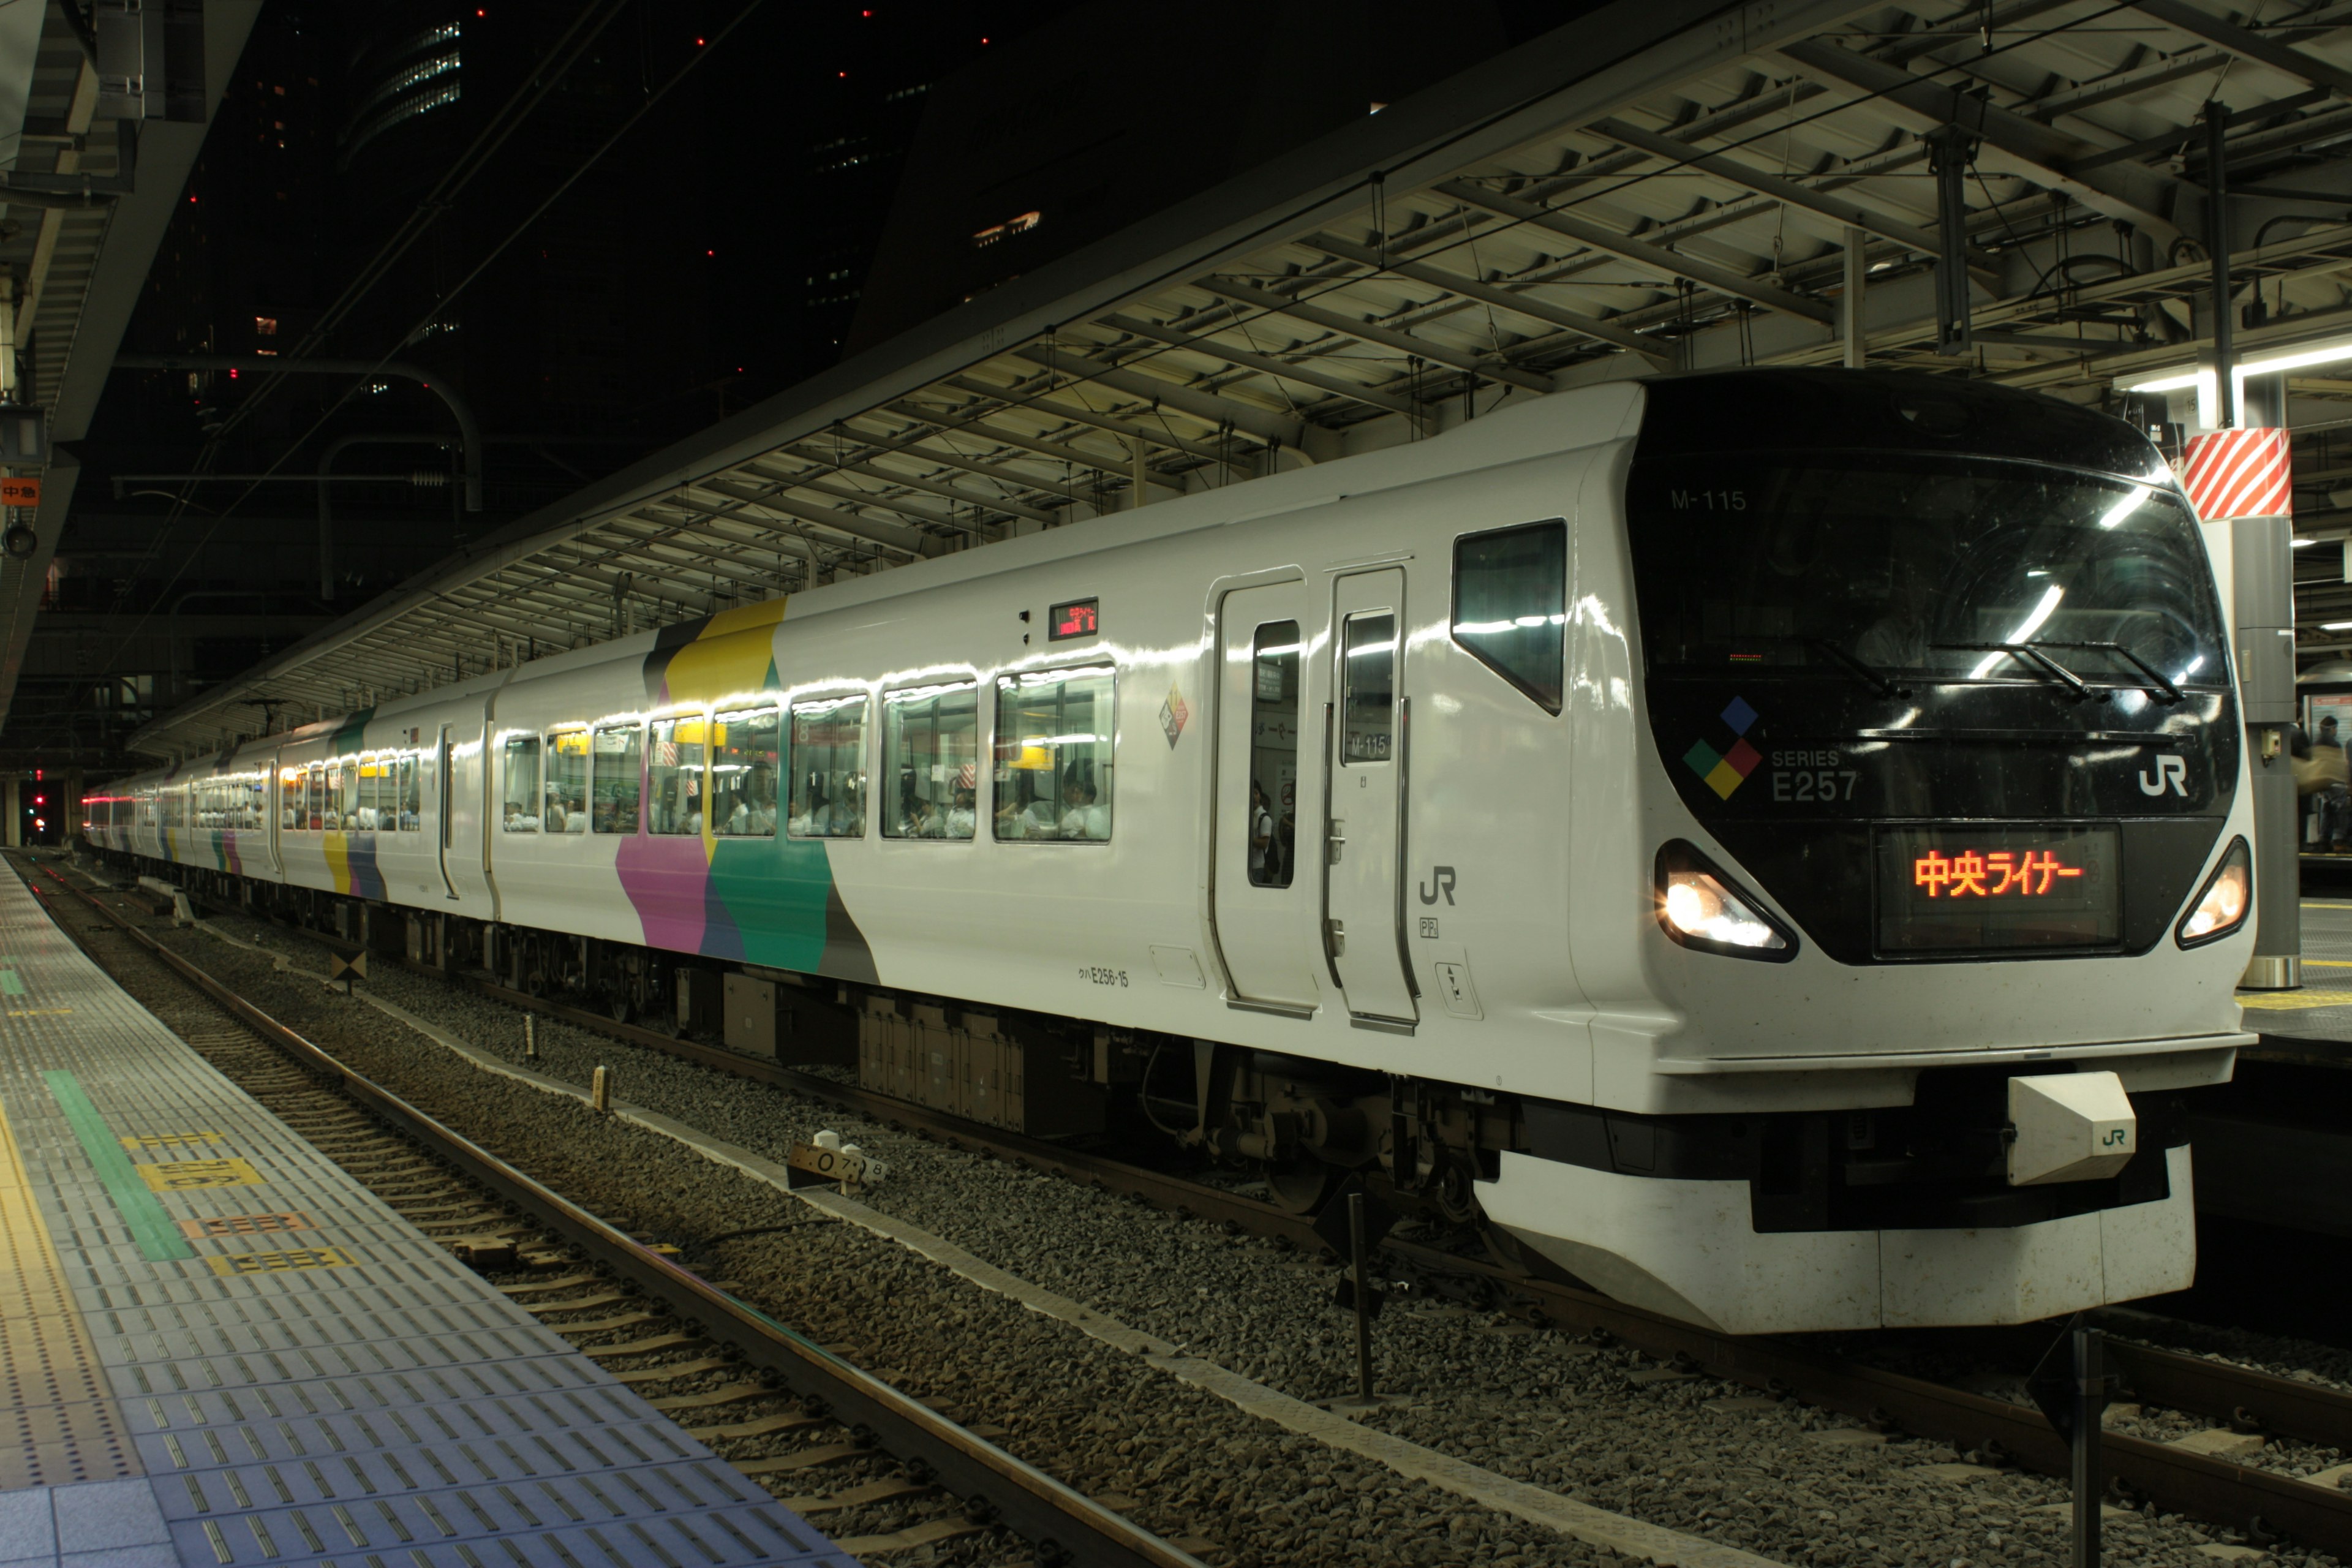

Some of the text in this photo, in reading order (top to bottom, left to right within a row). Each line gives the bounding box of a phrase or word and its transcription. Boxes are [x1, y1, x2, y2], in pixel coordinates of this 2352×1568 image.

[4, 486, 36, 498] 中急
[1671, 490, 1746, 510] M-115
[1351, 736, 1385, 756] M-115
[1772, 750, 1839, 766] SERIES
[2139, 754, 2187, 797] JR
[1773, 771, 1857, 801] E257
[1915, 850, 2081, 897] 中央ライナー
[1420, 865, 1456, 906] JR
[2102, 1129, 2125, 1147] JR
